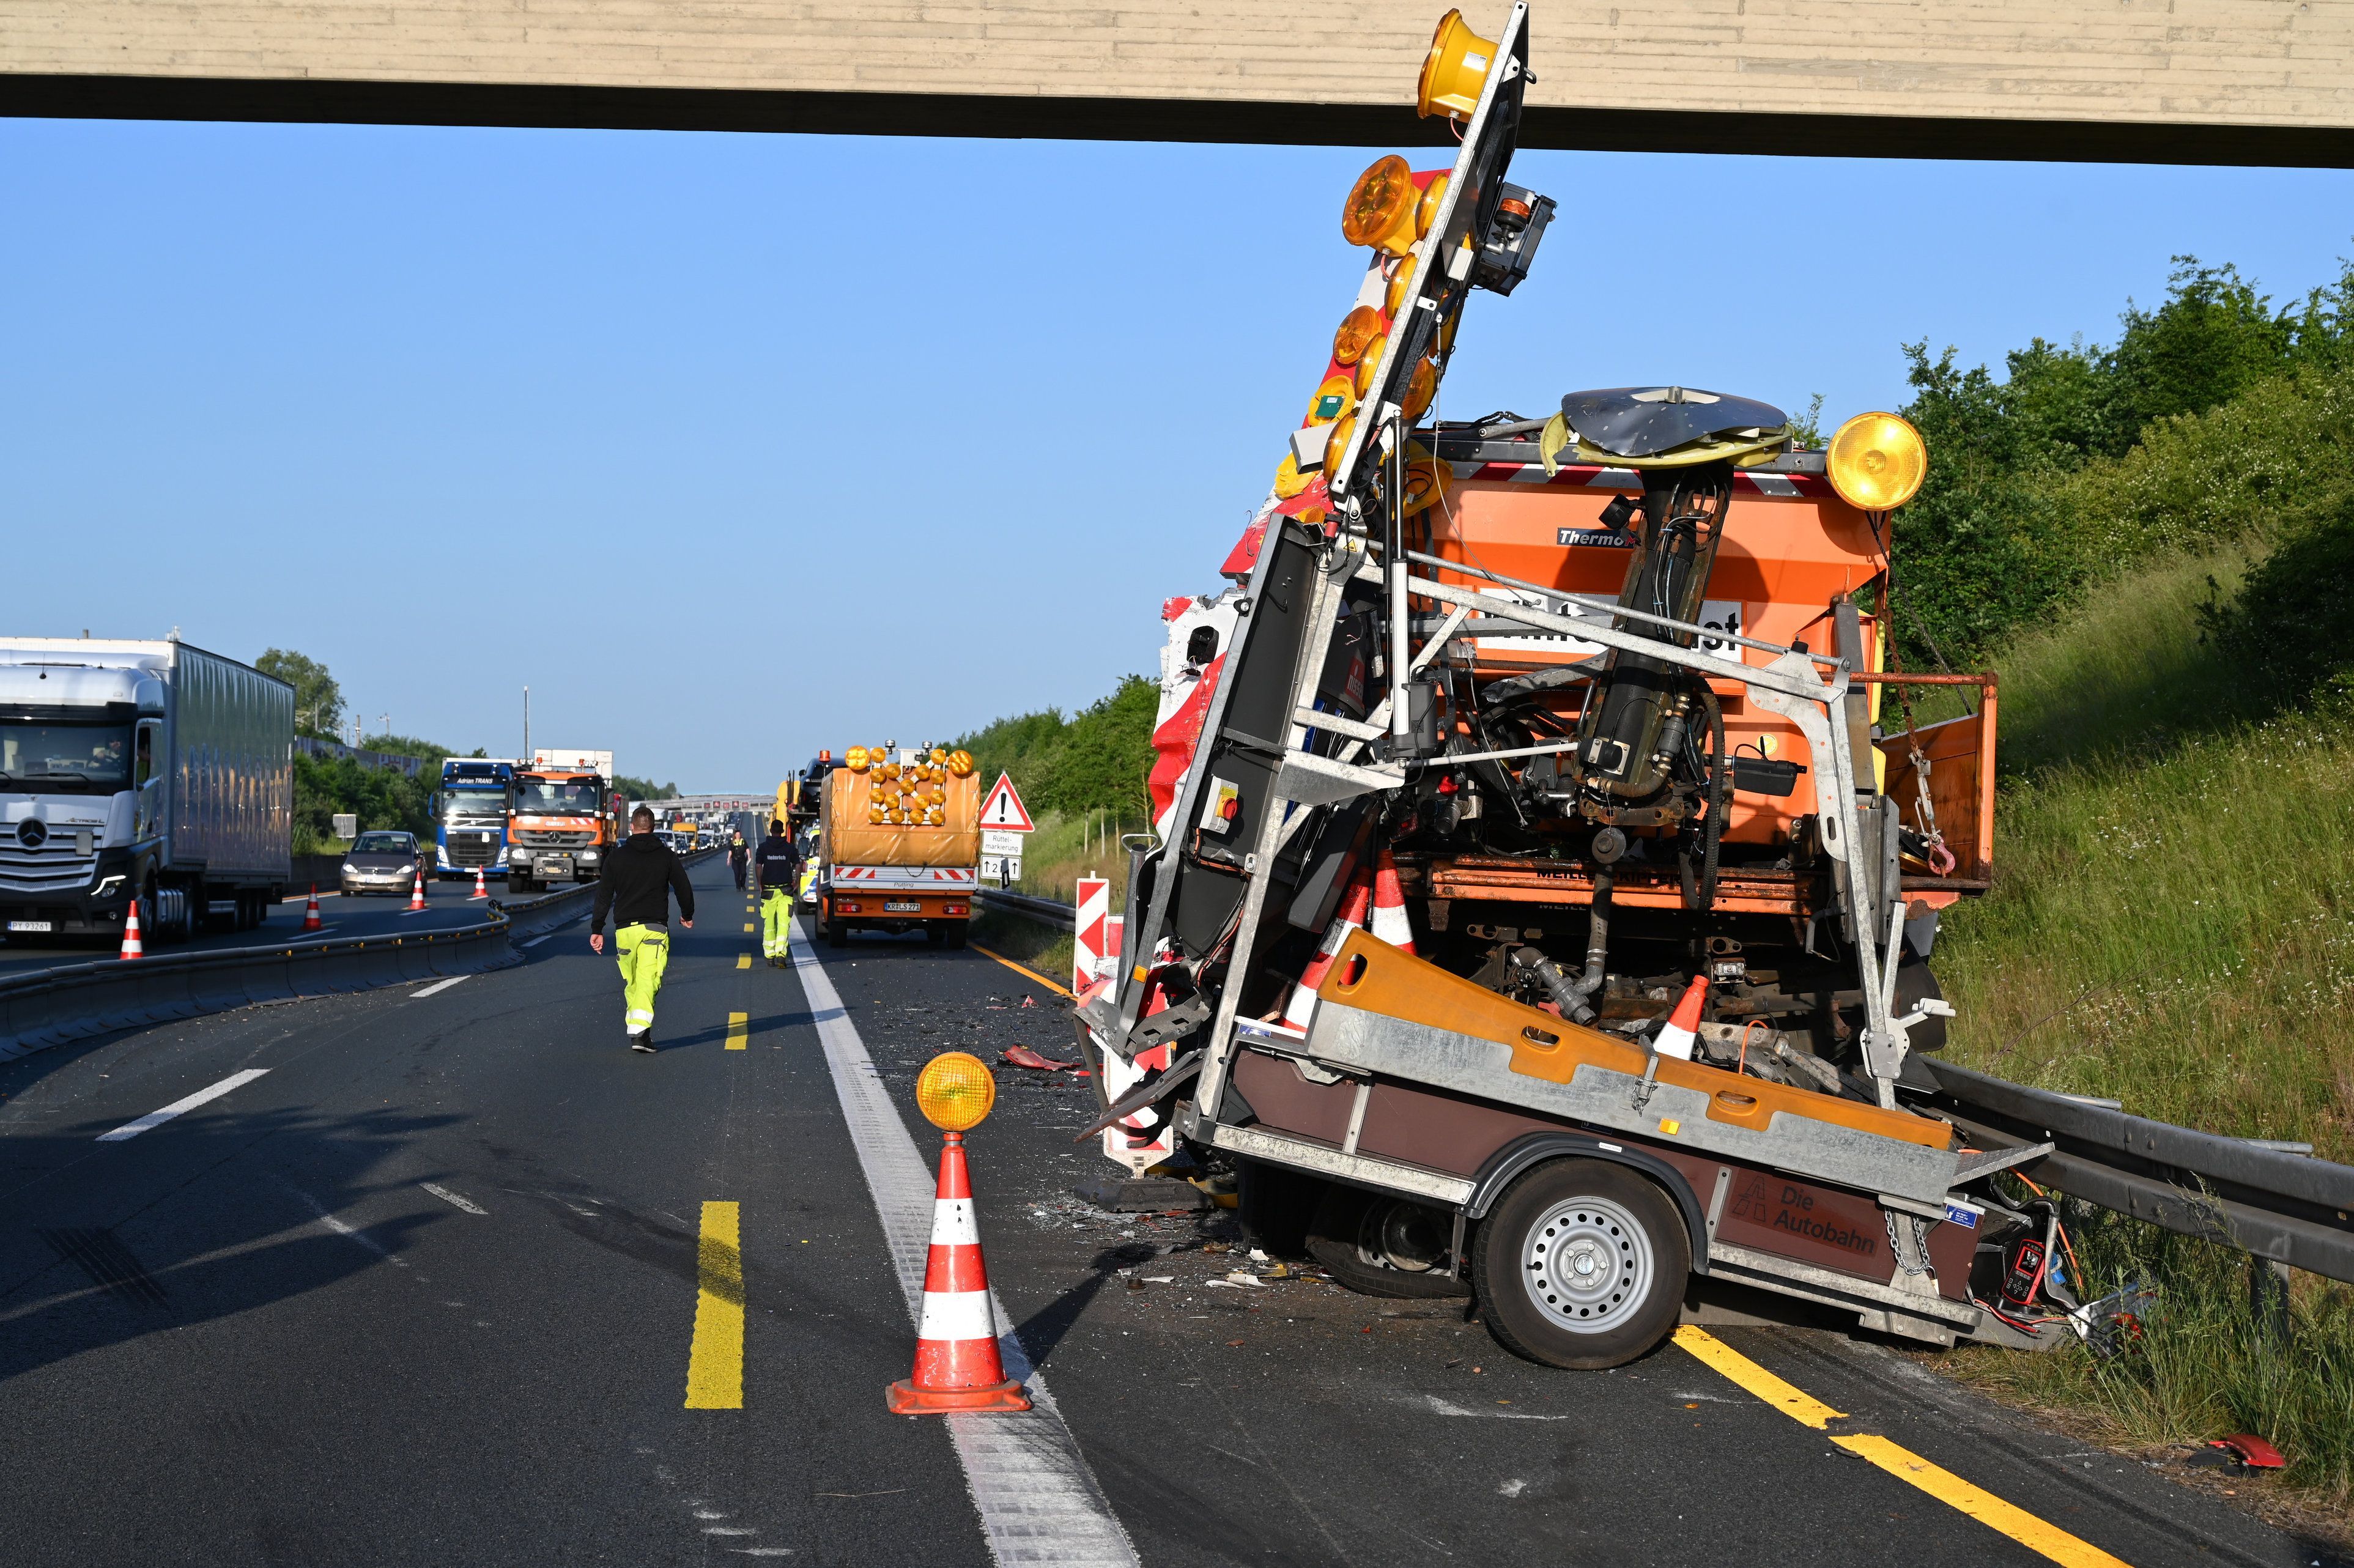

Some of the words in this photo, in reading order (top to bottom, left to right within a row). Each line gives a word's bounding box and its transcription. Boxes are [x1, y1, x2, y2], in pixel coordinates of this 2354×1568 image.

[985, 843, 1018, 853] markierung
[992, 863, 997, 873] 2
[1780, 1185, 1814, 1211] Die
[1774, 1209, 1875, 1254] Autobahn
